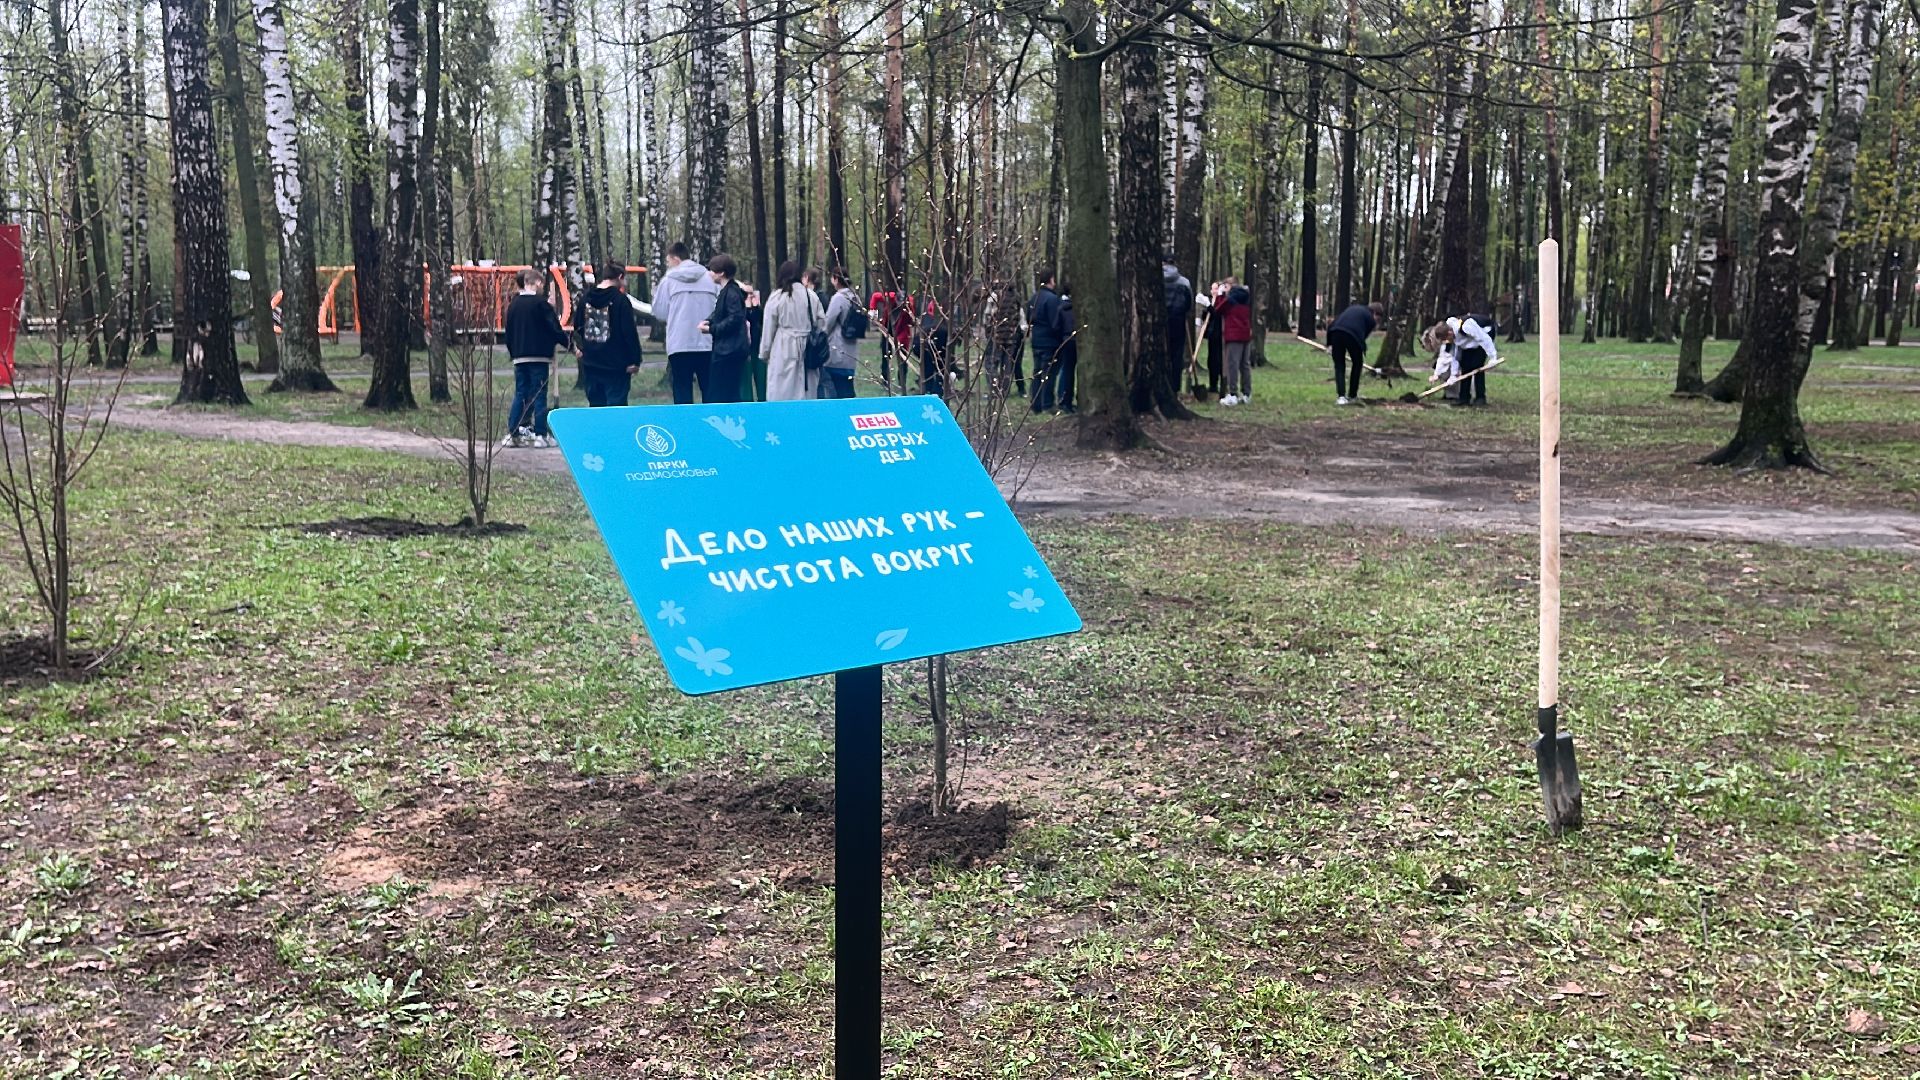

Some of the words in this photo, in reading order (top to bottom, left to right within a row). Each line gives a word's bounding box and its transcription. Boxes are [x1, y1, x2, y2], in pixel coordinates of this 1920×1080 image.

[856, 416, 897, 429] ДЕНЬ
[847, 431, 929, 452] ДОБРЫХ
[879, 448, 916, 464] ДЕЛ
[647, 459, 688, 471] ПАРКИ
[625, 466, 718, 481] ПОДМОСКОВЬЯ
